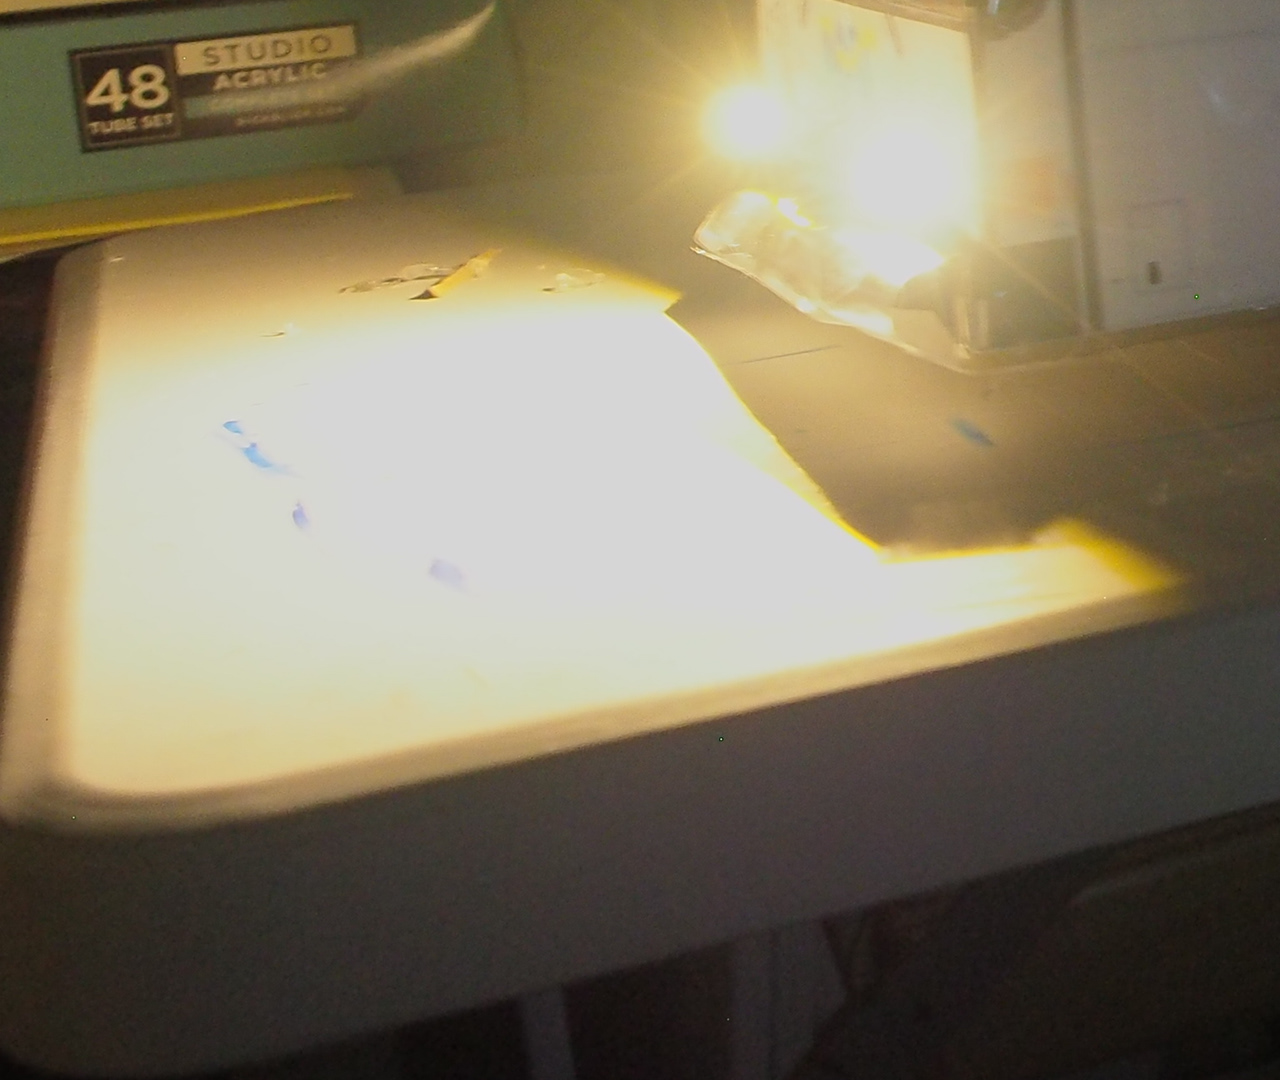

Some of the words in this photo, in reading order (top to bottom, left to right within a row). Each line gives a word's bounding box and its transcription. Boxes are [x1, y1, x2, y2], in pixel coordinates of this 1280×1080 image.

[202, 33, 332, 67] STUDIO
[85, 63, 171, 113] 48
[211, 62, 328, 91] ACRYLIC
[88, 117, 138, 134] TUBE
[140, 112, 175, 129] SET
